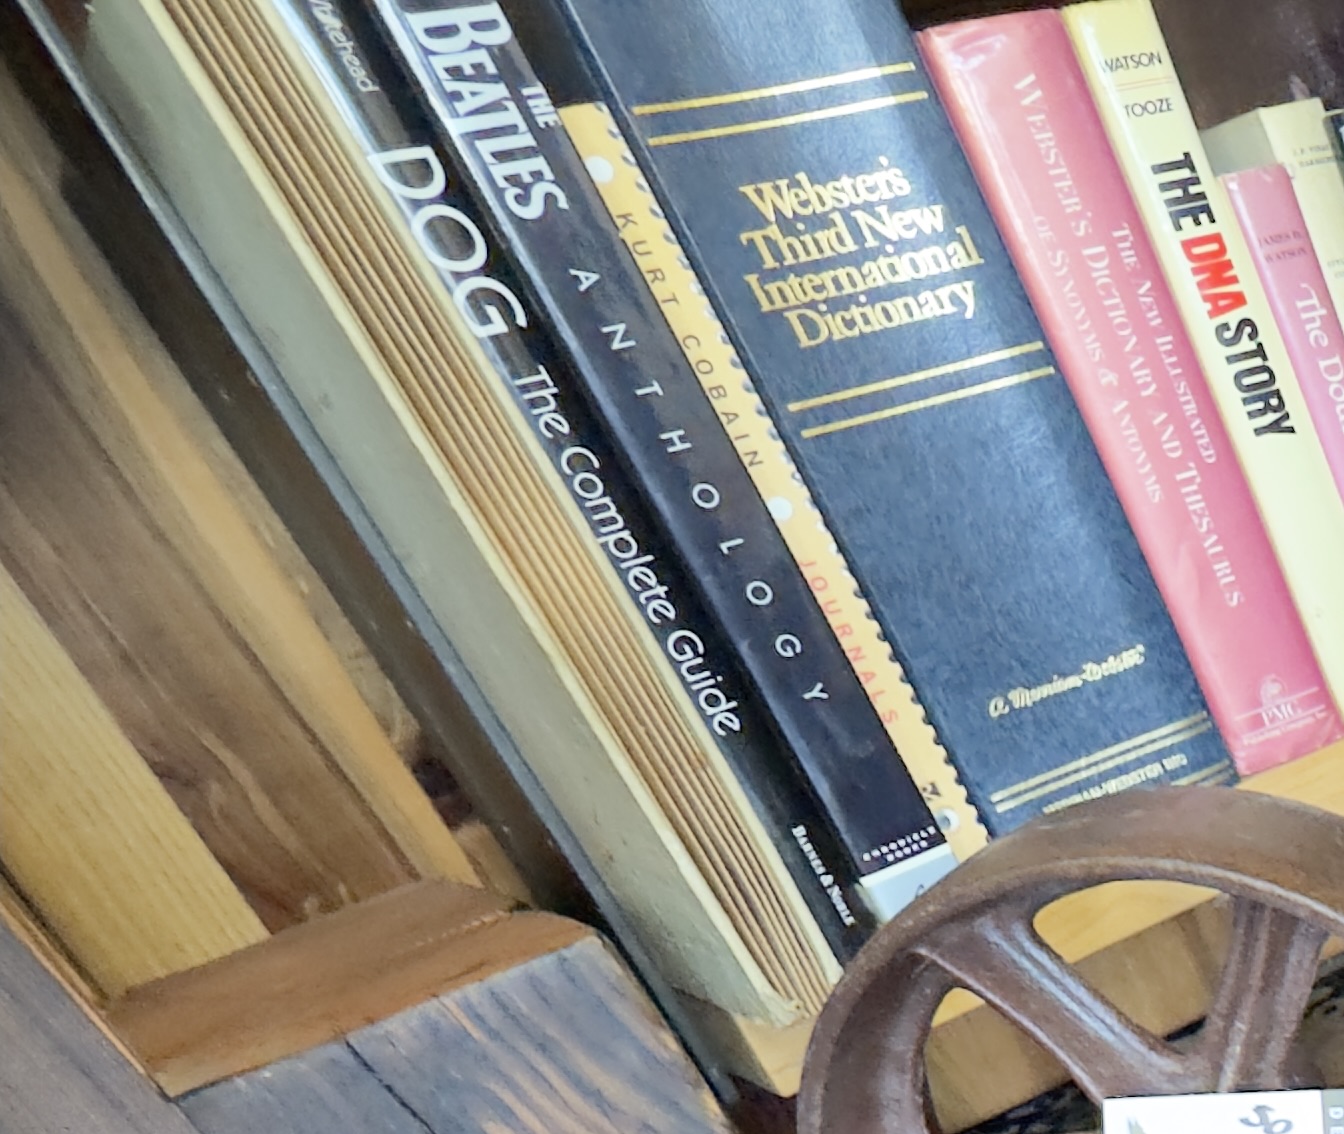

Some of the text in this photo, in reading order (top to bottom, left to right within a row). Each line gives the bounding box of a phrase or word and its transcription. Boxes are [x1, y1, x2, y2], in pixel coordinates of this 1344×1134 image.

[405, 3, 570, 220] BEATLES
[521, 81, 563, 129] THE
[1100, 51, 1162, 75] WATSON
[1124, 98, 1174, 119] TOOZE
[739, 155, 911, 222] Webster's
[739, 204, 944, 270] Third New
[743, 225, 985, 313] International
[784, 280, 976, 349] Dictionary
[1112, 222, 1141, 272] THE
[1132, 278, 1164, 330] NEW
[1151, 152, 1297, 437] THE DNA STORY
[1296, 283, 1328, 348] The
[616, 212, 763, 468] KURT COBAIN
[1014, 73, 1244, 608] WEBSTER'S DICTIONARY AND THESAURUS
[1049, 249, 1106, 362] SYNONYMS
[1098, 368, 1119, 387] &
[1110, 399, 1164, 504] ANTONYMS
[367, 145, 741, 736] DOG The Complete Guide
[568, 268, 829, 700] ANTHOLOGY
[800, 559, 899, 725] JOURNALS
